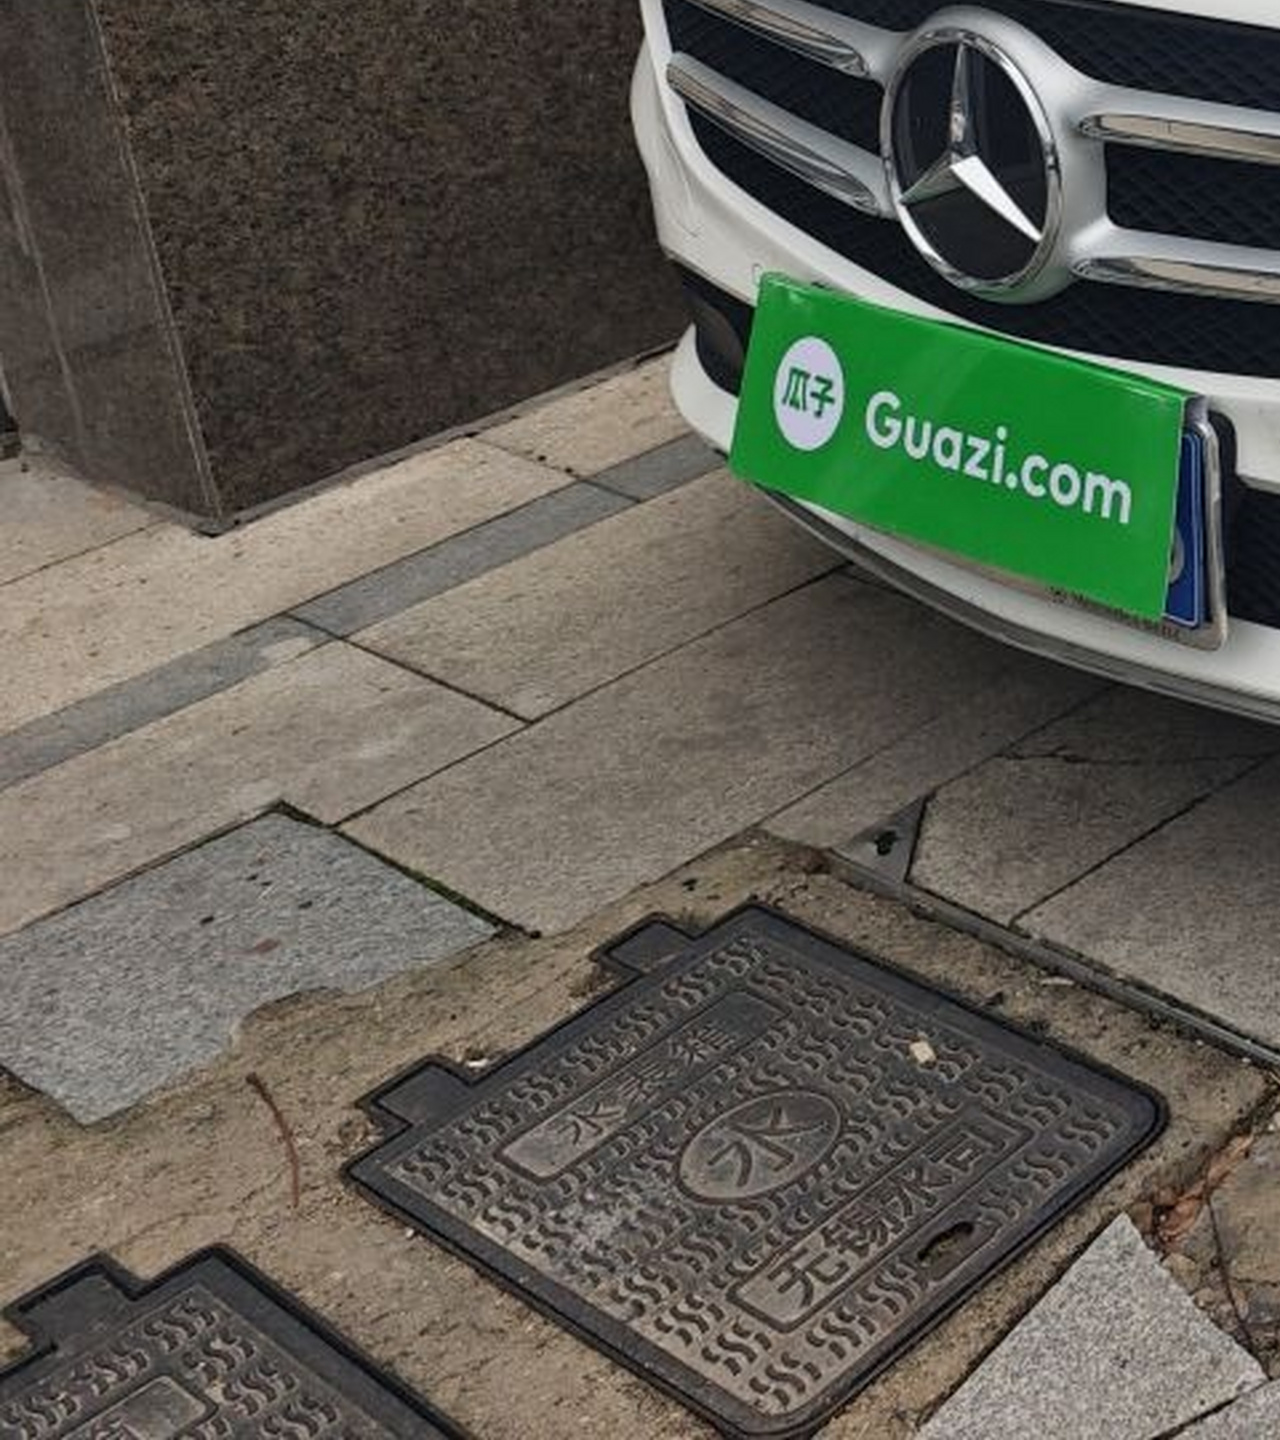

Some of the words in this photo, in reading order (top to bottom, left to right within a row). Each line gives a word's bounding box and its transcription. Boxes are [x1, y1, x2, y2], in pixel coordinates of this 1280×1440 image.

[781, 366, 836, 419] 瓜子
[866, 391, 1132, 524] Guazi.com
[706, 1106, 831, 1189] 水
